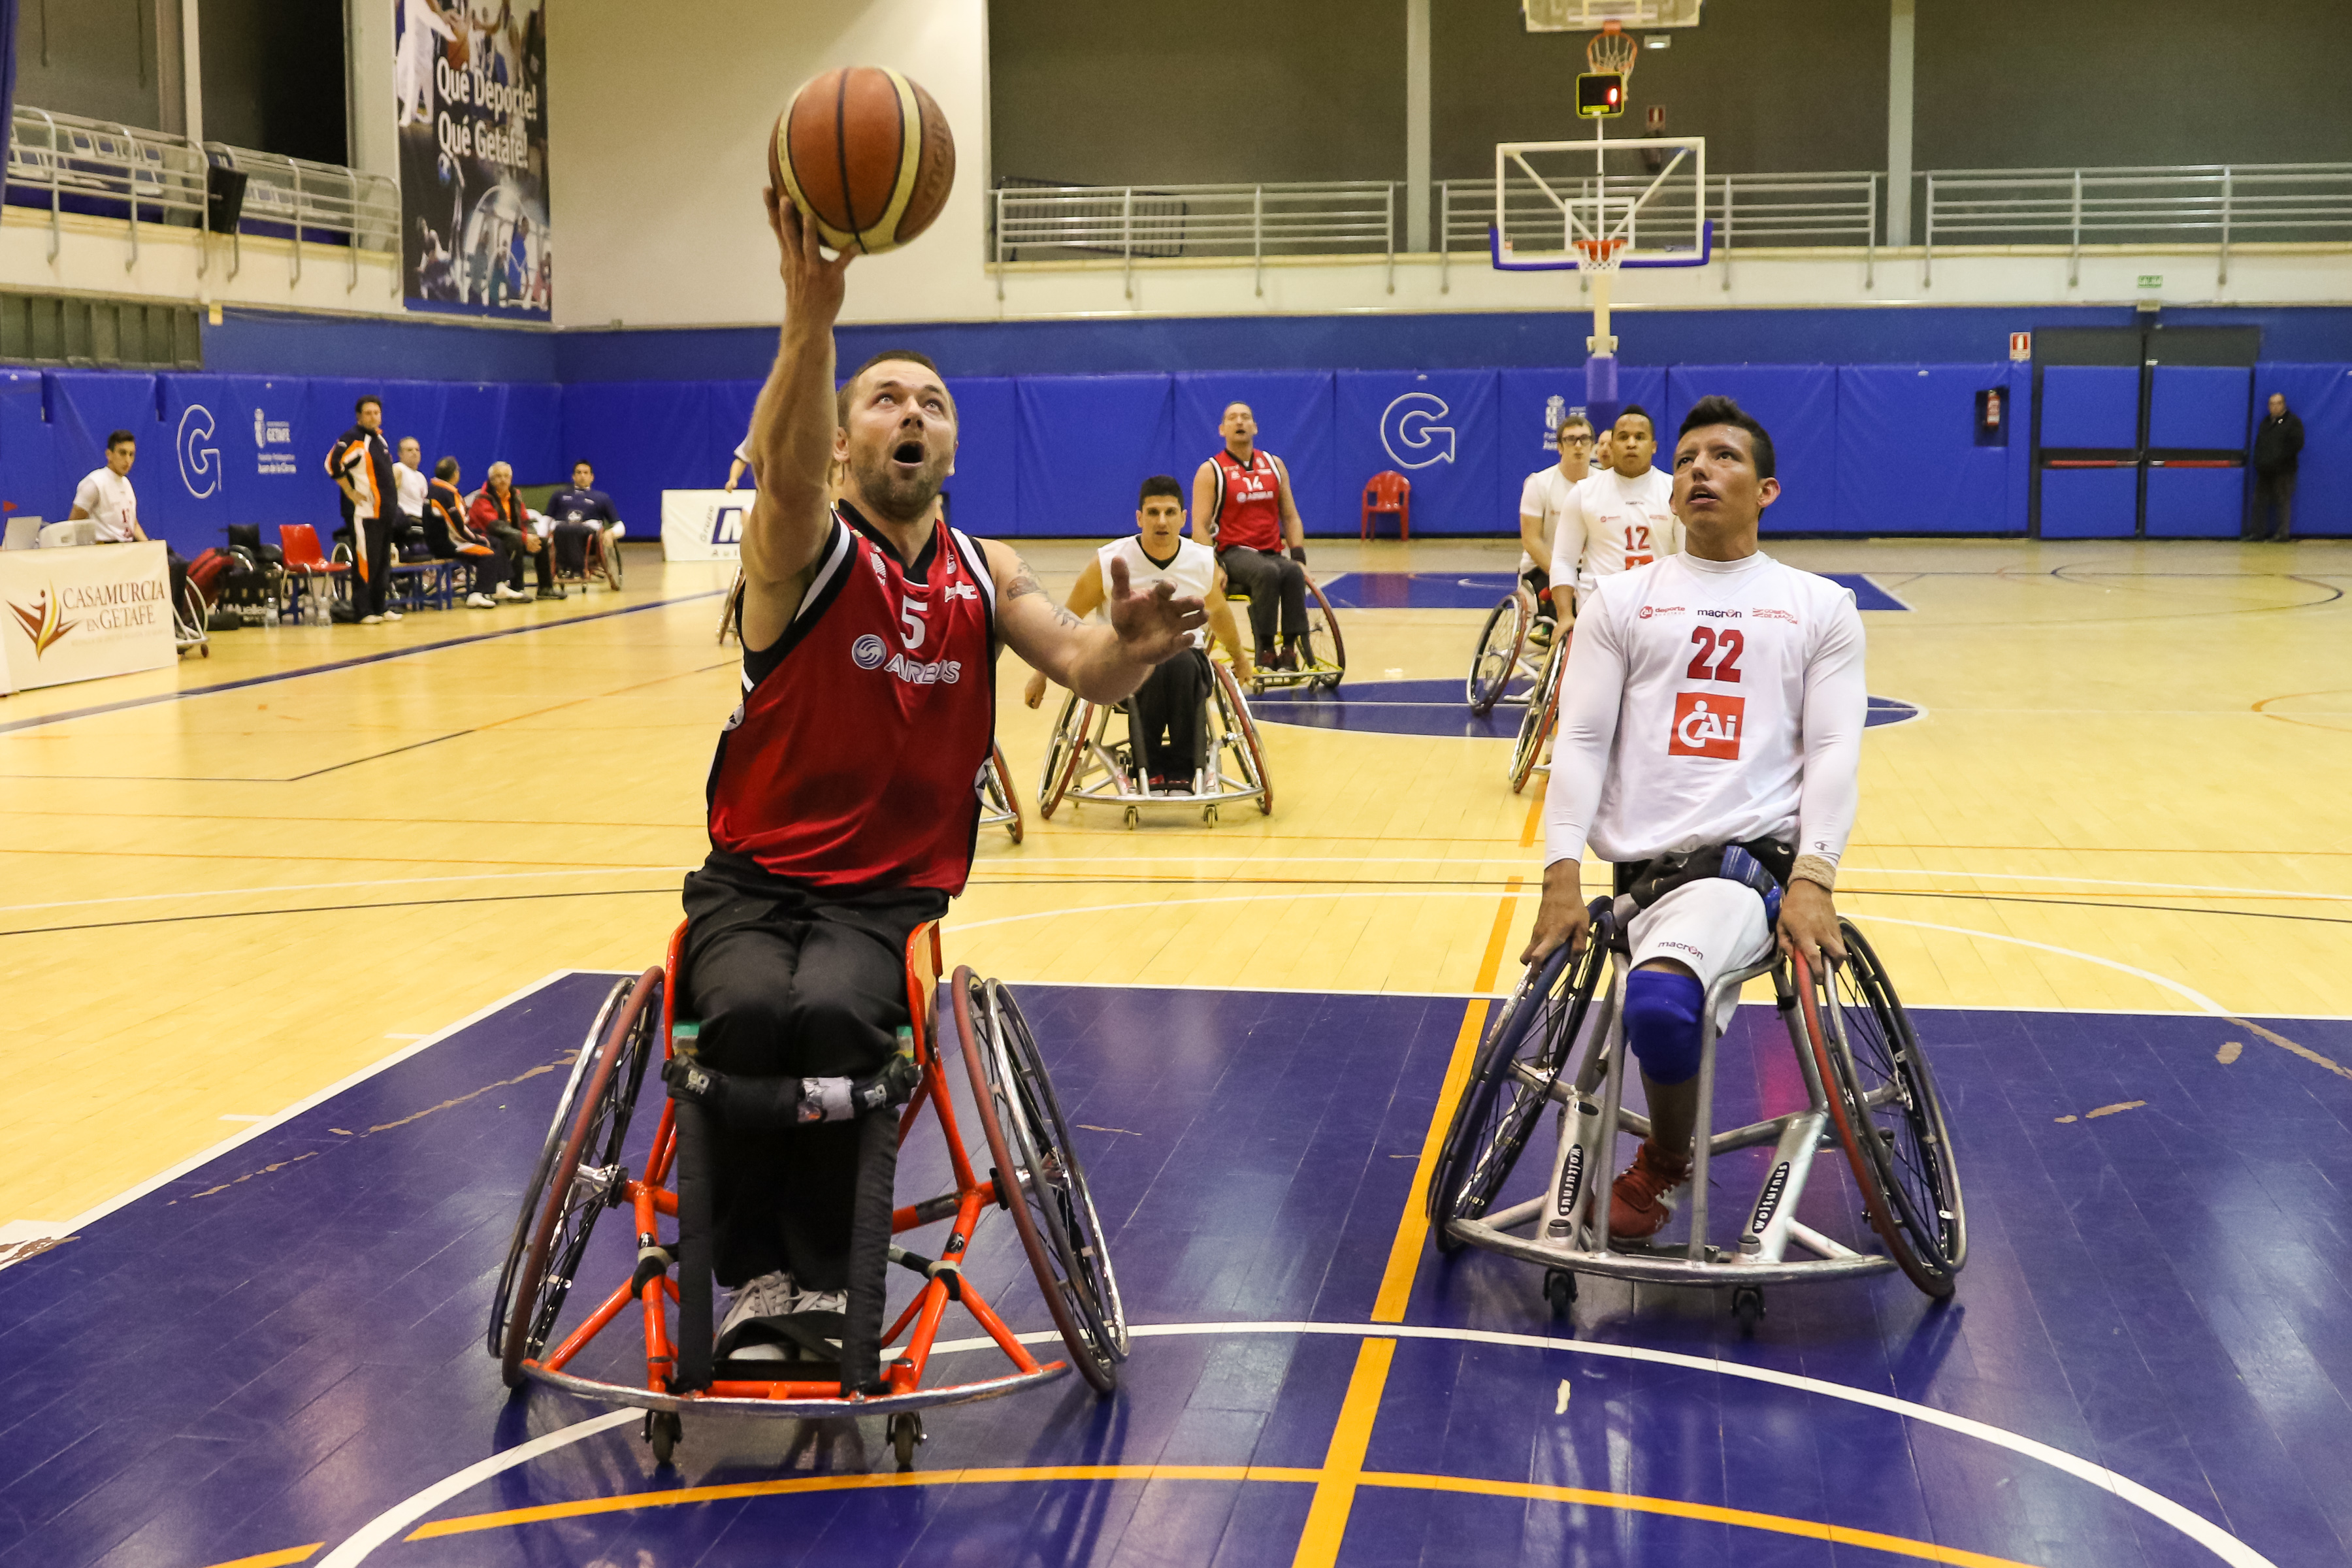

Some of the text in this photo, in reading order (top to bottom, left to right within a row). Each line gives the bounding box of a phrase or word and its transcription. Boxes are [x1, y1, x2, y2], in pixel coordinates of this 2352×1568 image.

[436, 56, 538, 122] Qué Deporte!
[438, 110, 528, 169] Qué Getafe!
[1242, 476, 1264, 491] 14
[1625, 525, 1651, 550] 12
[63, 580, 165, 609] CASAMURCIA
[1697, 609, 1742, 619] macron
[99, 604, 155, 629] GETAFE
[900, 595, 928, 649] 5
[1686, 625, 1744, 683] 22
[1658, 941, 1704, 960] macron
[1560, 1148, 1582, 1213] wolturnus
[1754, 1164, 1788, 1230] wolturnus
